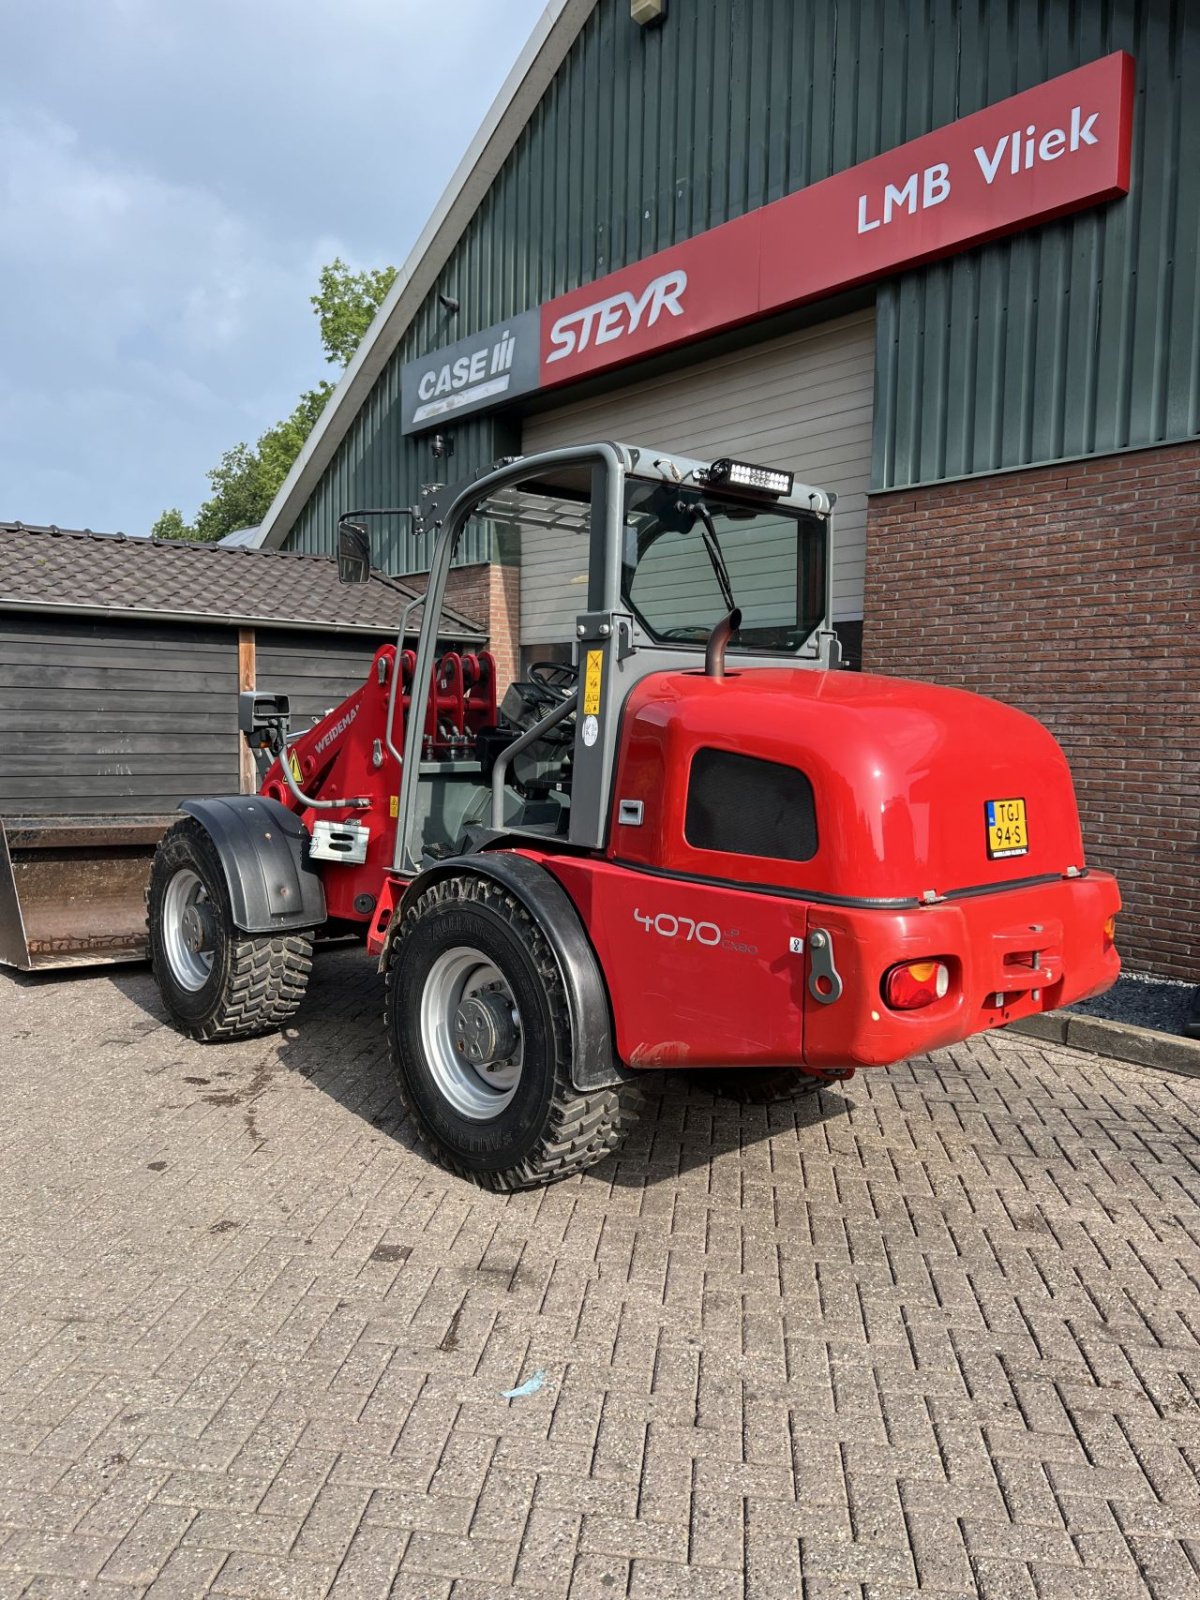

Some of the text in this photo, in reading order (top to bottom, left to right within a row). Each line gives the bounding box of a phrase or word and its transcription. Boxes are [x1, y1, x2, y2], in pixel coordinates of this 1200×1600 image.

[857, 105, 1100, 235] LMB Vliek
[545, 269, 688, 364] STEYR
[418, 348, 489, 401] CASE
[998, 803, 1020, 823] TGJ
[633, 907, 721, 946] 4070
